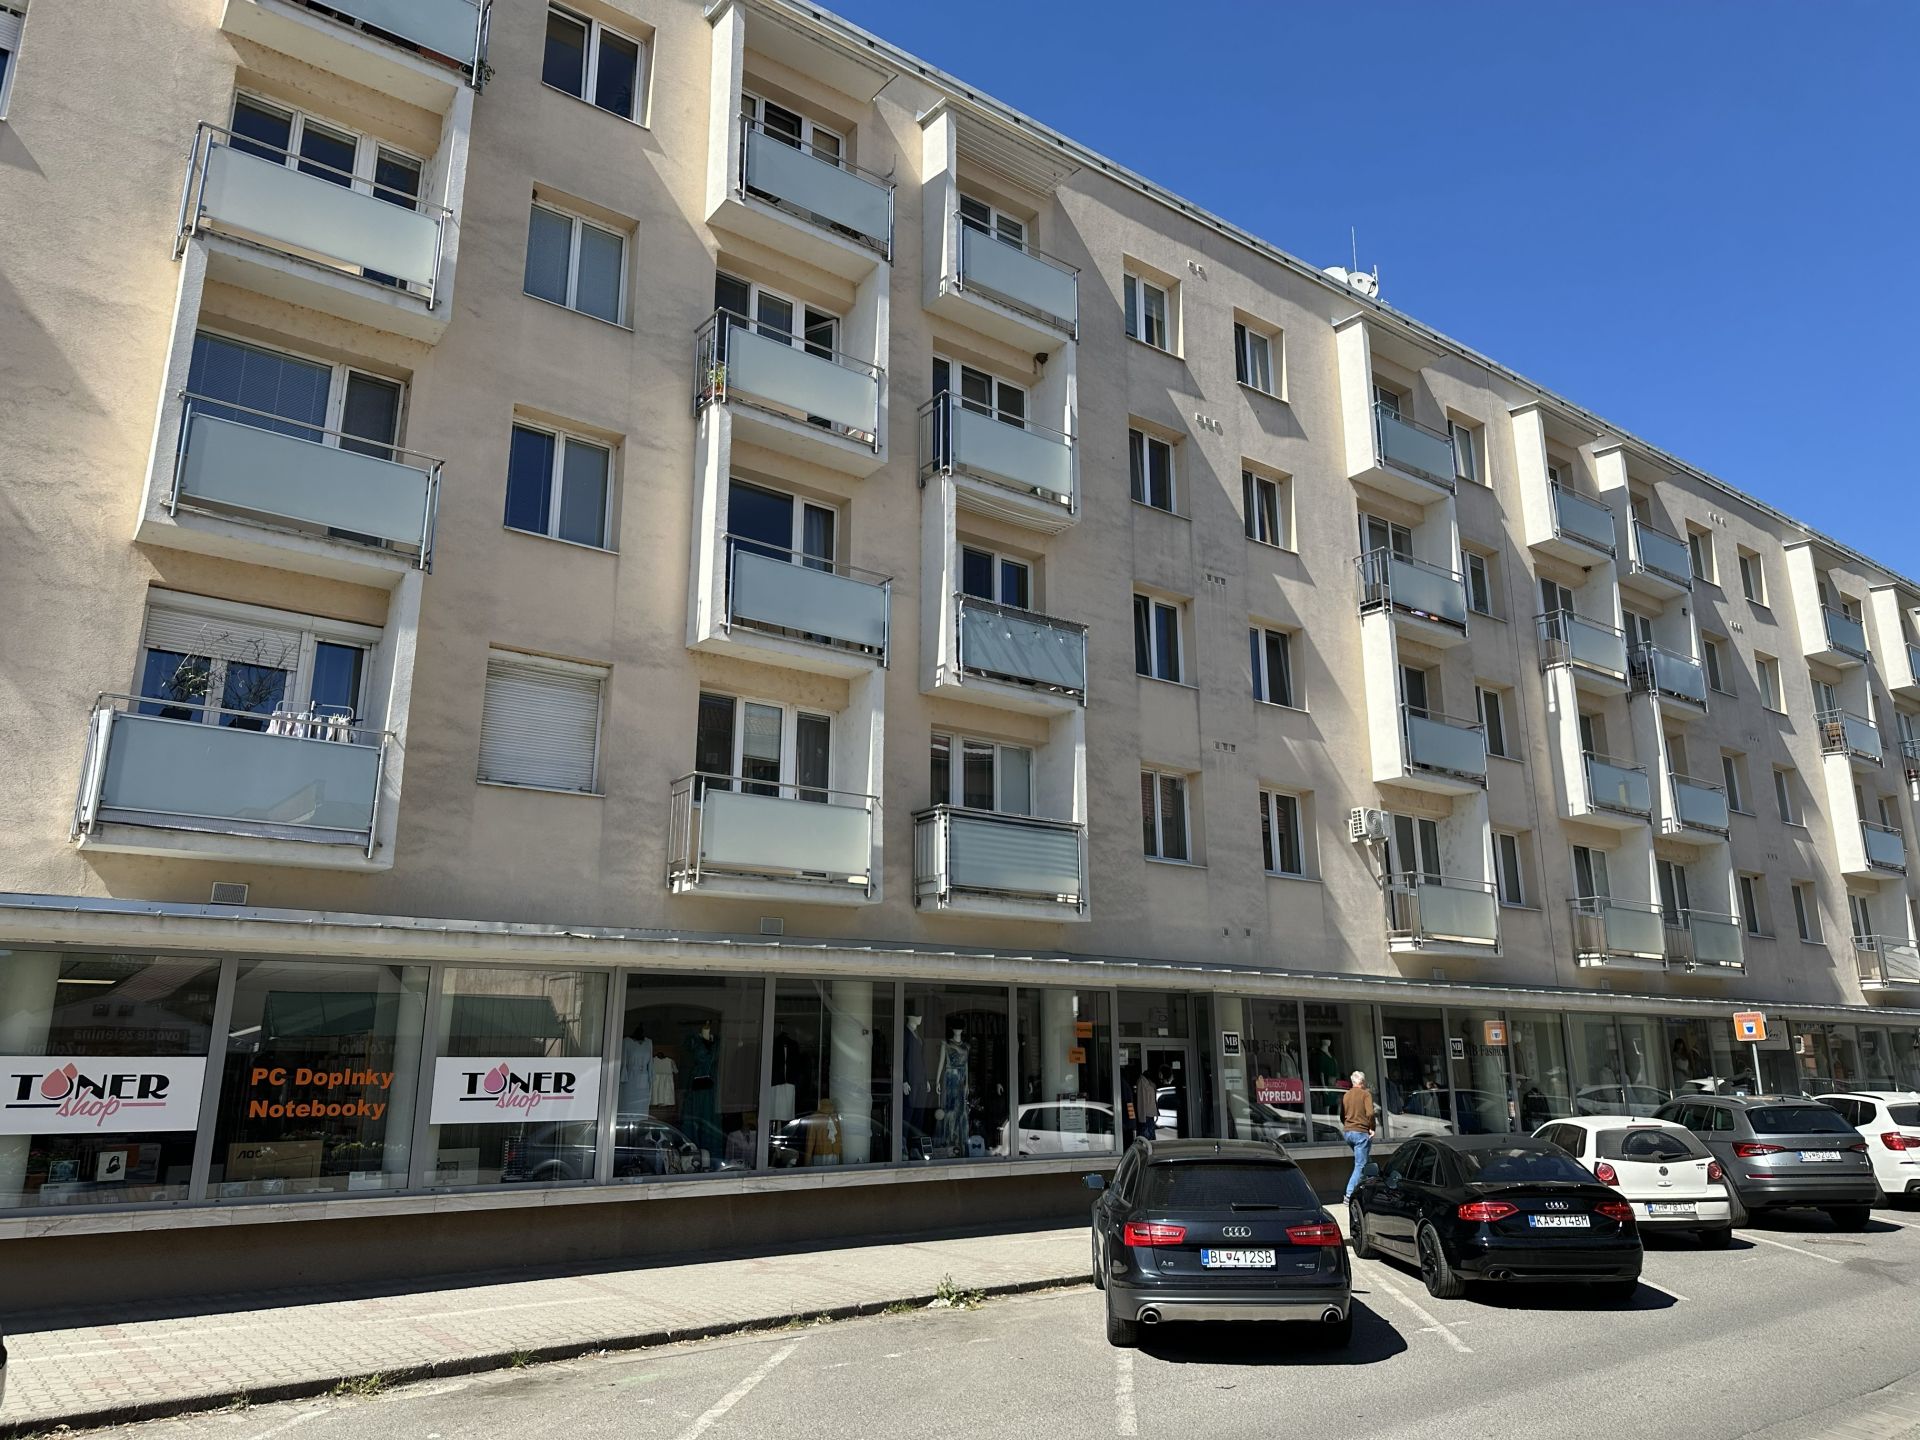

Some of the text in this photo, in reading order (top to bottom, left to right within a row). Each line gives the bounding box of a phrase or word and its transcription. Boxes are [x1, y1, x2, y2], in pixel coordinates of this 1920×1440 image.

[1225, 1036, 1238, 1046] MB
[1384, 1040, 1395, 1049] MB
[1451, 1042, 1462, 1051] MB
[11, 1063, 170, 1100] TONER
[251, 1067, 395, 1090] PC Doplnky
[461, 1063, 576, 1095] TONER
[496, 1082, 543, 1117] shop
[1257, 1087, 1302, 1102] VÝPREDAJ
[56, 1087, 120, 1127] shop
[248, 1099, 386, 1121] Notebooky
